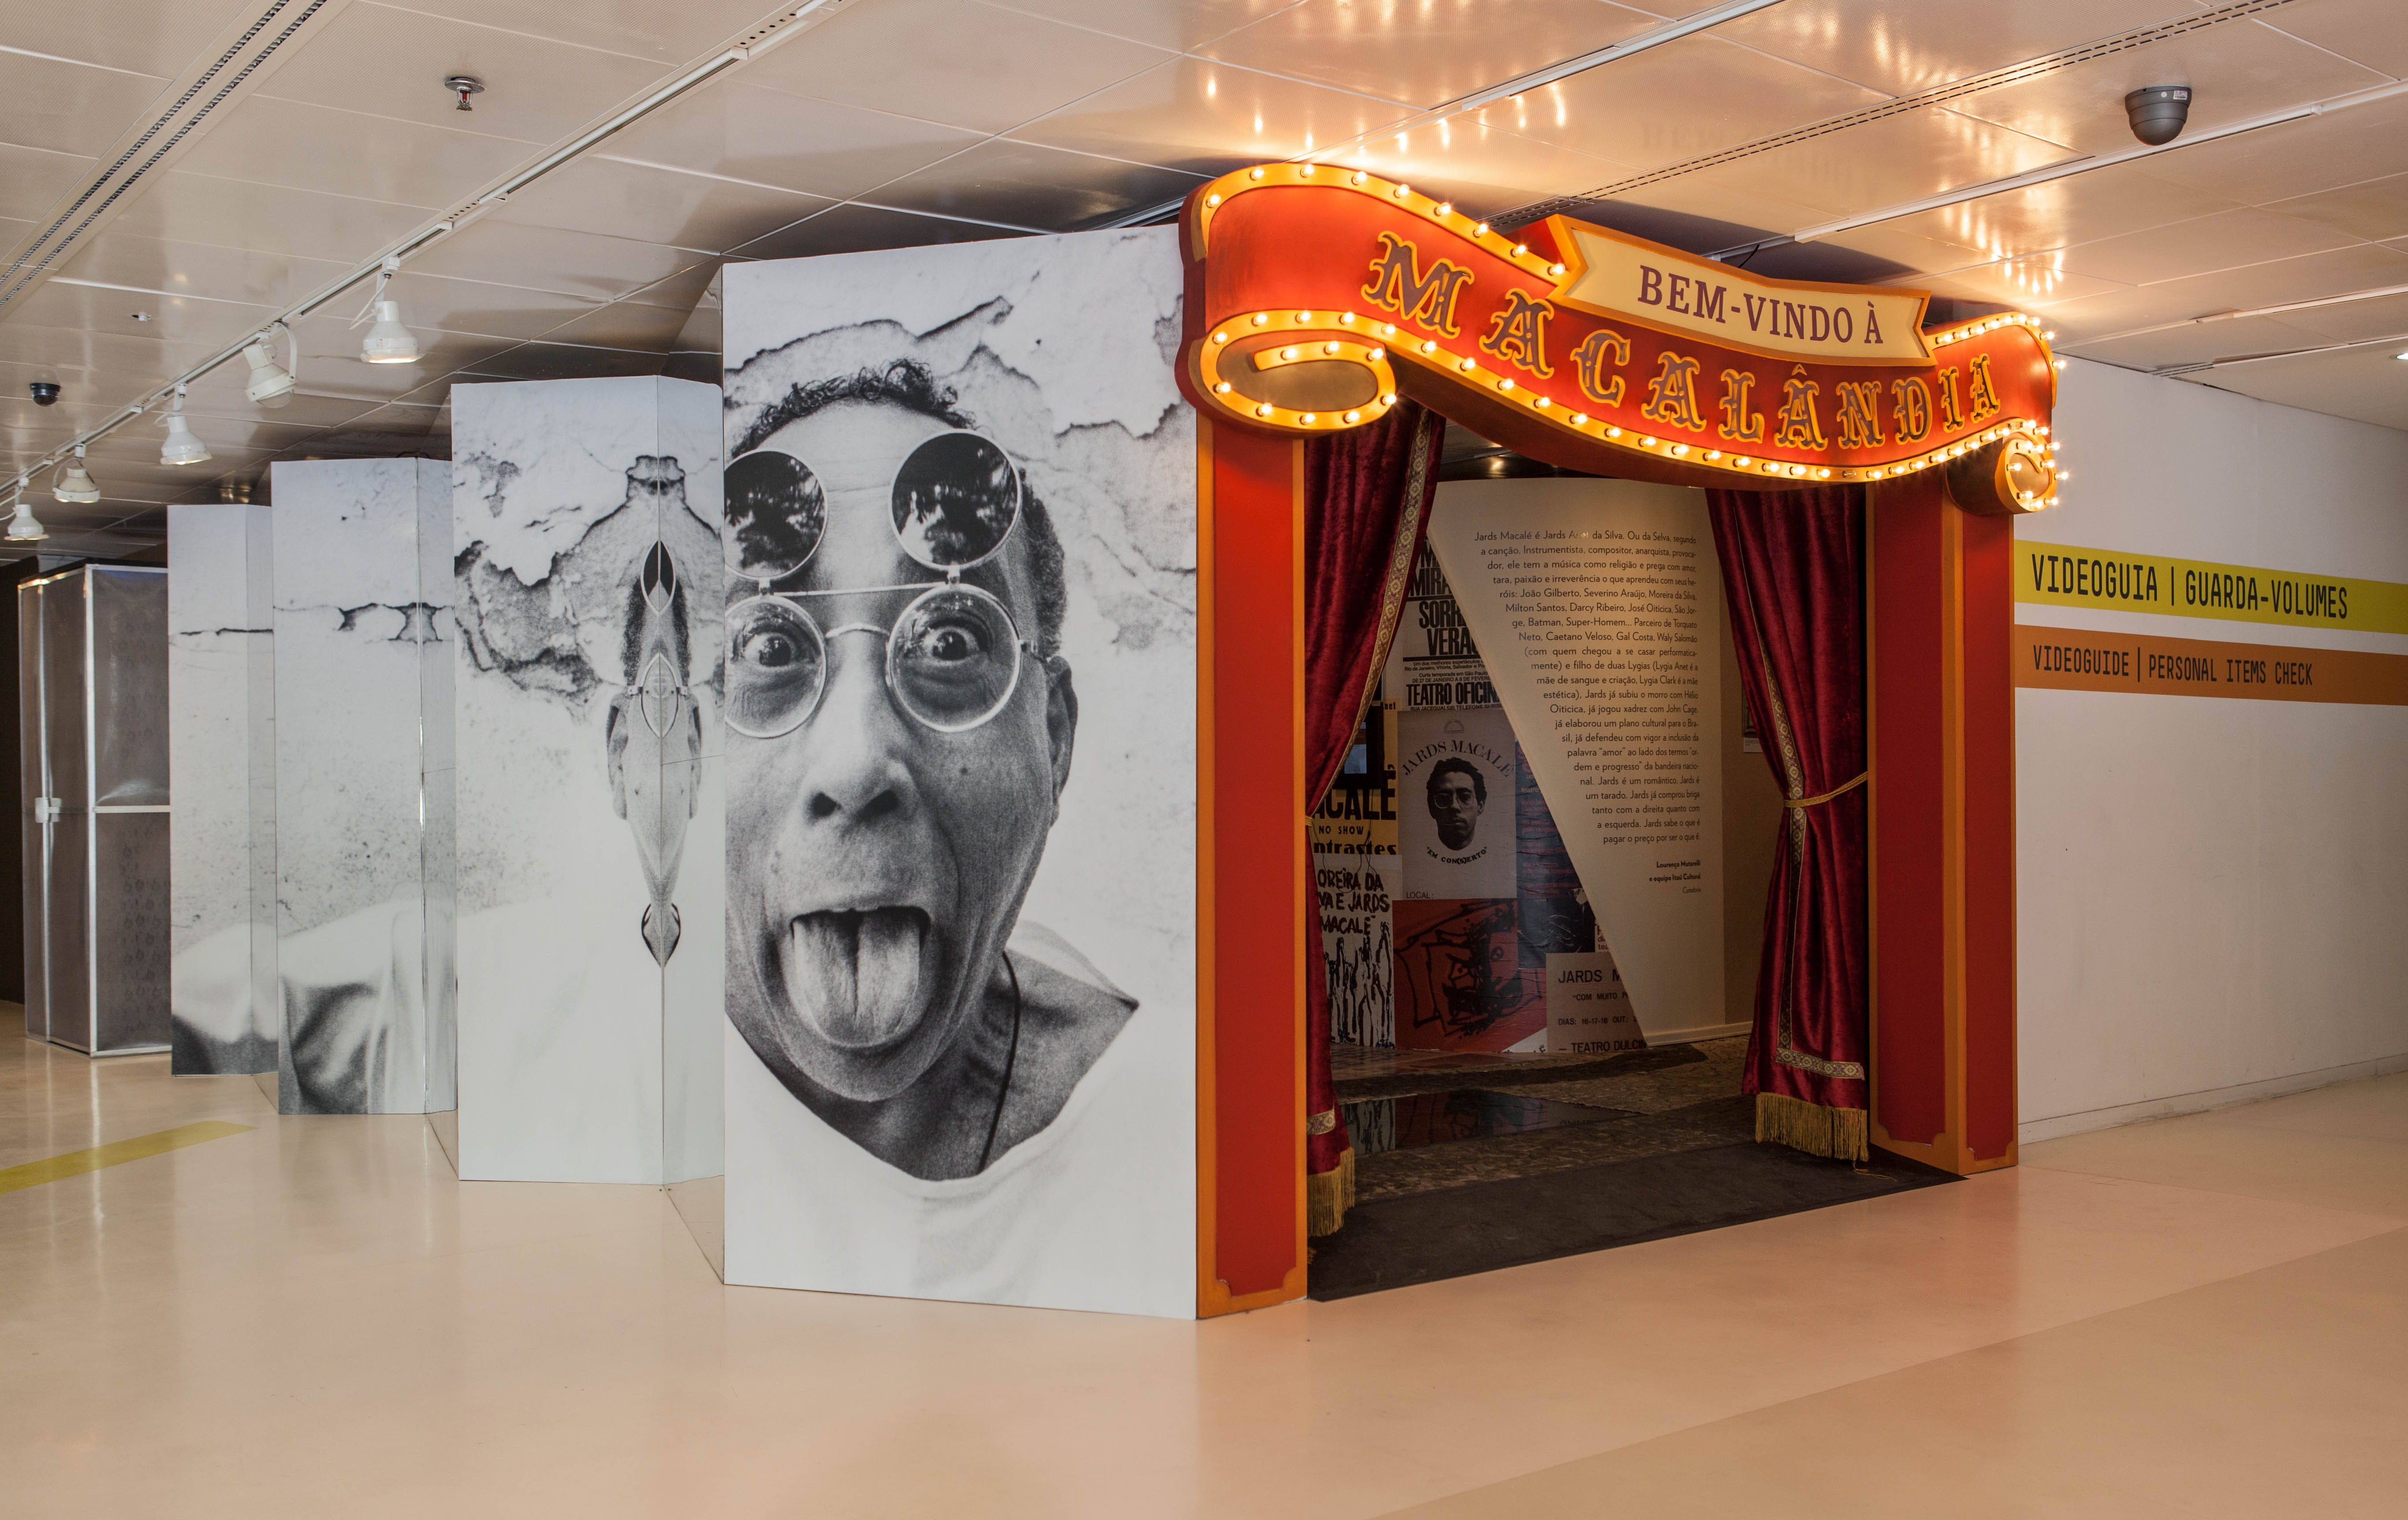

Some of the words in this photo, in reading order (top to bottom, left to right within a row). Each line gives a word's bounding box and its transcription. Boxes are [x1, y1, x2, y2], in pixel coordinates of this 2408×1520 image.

[1638, 265, 1852, 343] BEM-VINDO
[1864, 300, 1883, 343] À
[1361, 231, 2000, 451] MACALÂNDIA
[1488, 547, 1521, 557] canção.
[1524, 545, 1585, 554] Instrumentista,
[1588, 546, 1633, 555] compositor,
[1635, 548, 1671, 557] anarquista,
[1487, 560, 1504, 570] dor,
[1507, 560, 1520, 569] ele
[1610, 559, 1637, 570] religião
[1647, 563, 1665, 572] prega
[1514, 575, 1542, 585] paixão
[1626, 574, 1659, 585] aprendeu
[1688, 577, 1696, 586] he-
[2032, 554, 2158, 601] VIDEOGUIA
[2185, 570, 2348, 619] GUARDA-VOLUMES
[1520, 589, 1541, 597] João
[1544, 588, 1581, 597] Gilberto,
[1584, 588, 1618, 597] Severino
[1620, 589, 1647, 600] Araújo,
[1649, 589, 1674, 599] Moreira
[1675, 590, 1682, 599] da
[1683, 591, 1697, 601] Silva,
[1506, 603, 1534, 612] Milton
[1536, 603, 1567, 612] Santos,
[1570, 602, 1594, 614] Darcy
[1596, 602, 1626, 612] Ribeiro,
[1628, 603, 1645, 612] José
[1646, 603, 1673, 614] Oiticica,
[1675, 604, 1685, 614] São
[1686, 606, 1697, 614] Jor-
[1528, 617, 1563, 626] Batman,
[1634, 617, 1662, 627] Parceiro
[1663, 618, 1672, 627] de
[1673, 618, 1697, 630] Torquato
[1519, 632, 1543, 641] Neto,
[1546, 631, 1582, 641] Caetano
[1584, 631, 1614, 641] Veloso,
[1616, 631, 1630, 641] Gal
[1633, 631, 1655, 641] Costa,
[1657, 632, 1673, 644] Waly
[1674, 633, 1697, 643] Salomão
[1525, 646, 1547, 657] (com
[1582, 646, 1612, 657] chegou
[2033, 645, 2129, 677] VIDEOGUIDE
[2149, 655, 2217, 682] PERSONAL
[2226, 659, 2266, 684] ITEMS
[2275, 662, 2313, 686] CHECK
[1406, 682, 1452, 706] TEATRO
[1402, 741, 1446, 775] JARDS
[1574, 762, 1592, 771] dem
[1644, 761, 1653, 770] da
[1655, 761, 1681, 770] bandeira
[1642, 804, 1664, 813] direita
[1666, 806, 1687, 815] quanto
[1319, 826, 1331, 835] NO
[1338, 826, 1364, 835] SHOW
[1603, 837, 1625, 845] pagar
[1634, 836, 1655, 844] preço
[1656, 861, 1680, 869] Lourenço
[1365, 872, 1384, 892] DA
[1336, 893, 1345, 910] E
[1348, 891, 1390, 914] JARDS
[1558, 970, 1602, 983] JARDS
[1571, 1041, 1610, 1052] TEATRO
